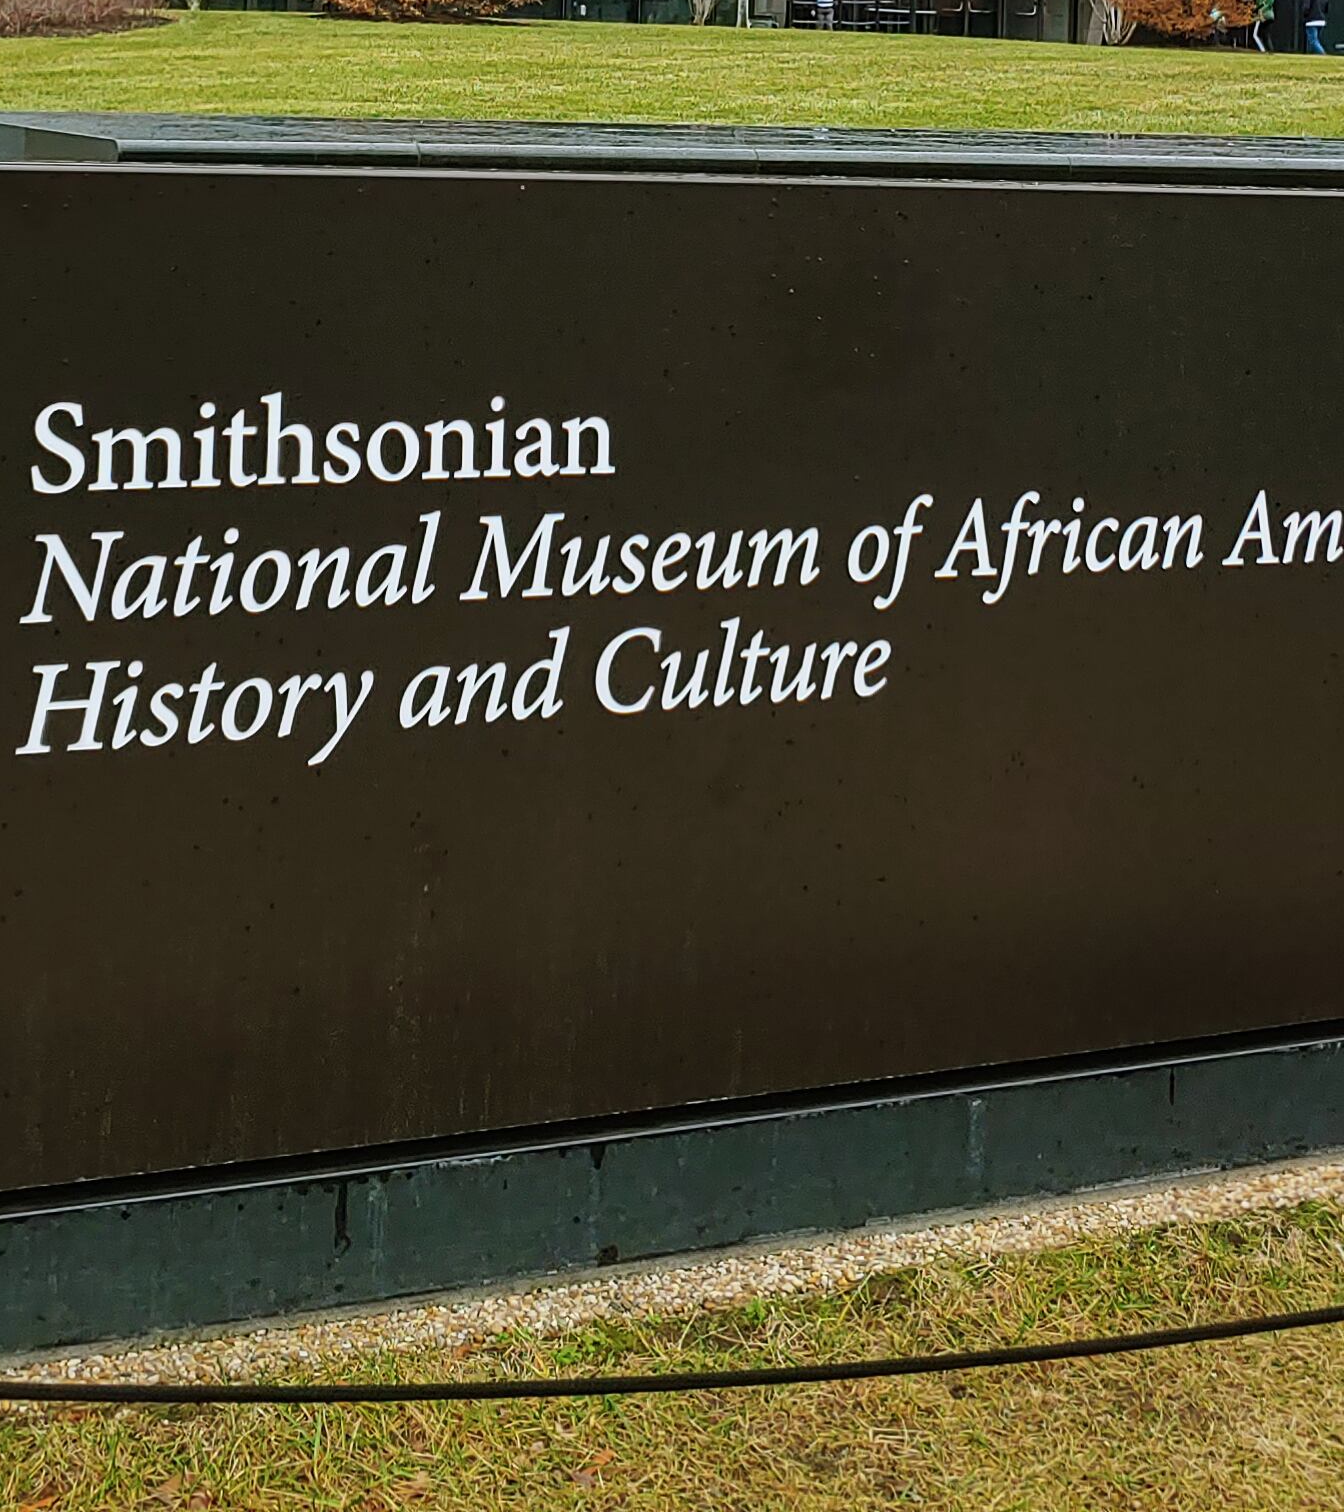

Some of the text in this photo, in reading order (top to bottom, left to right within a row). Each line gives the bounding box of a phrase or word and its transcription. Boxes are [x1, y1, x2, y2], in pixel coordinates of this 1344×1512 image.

[30, 391, 616, 494] Smithsonian
[19, 510, 442, 624] National
[459, 512, 820, 601] Museum
[847, 493, 934, 610] of
[934, 490, 1204, 605] African
[14, 616, 892, 767] History and Culture
